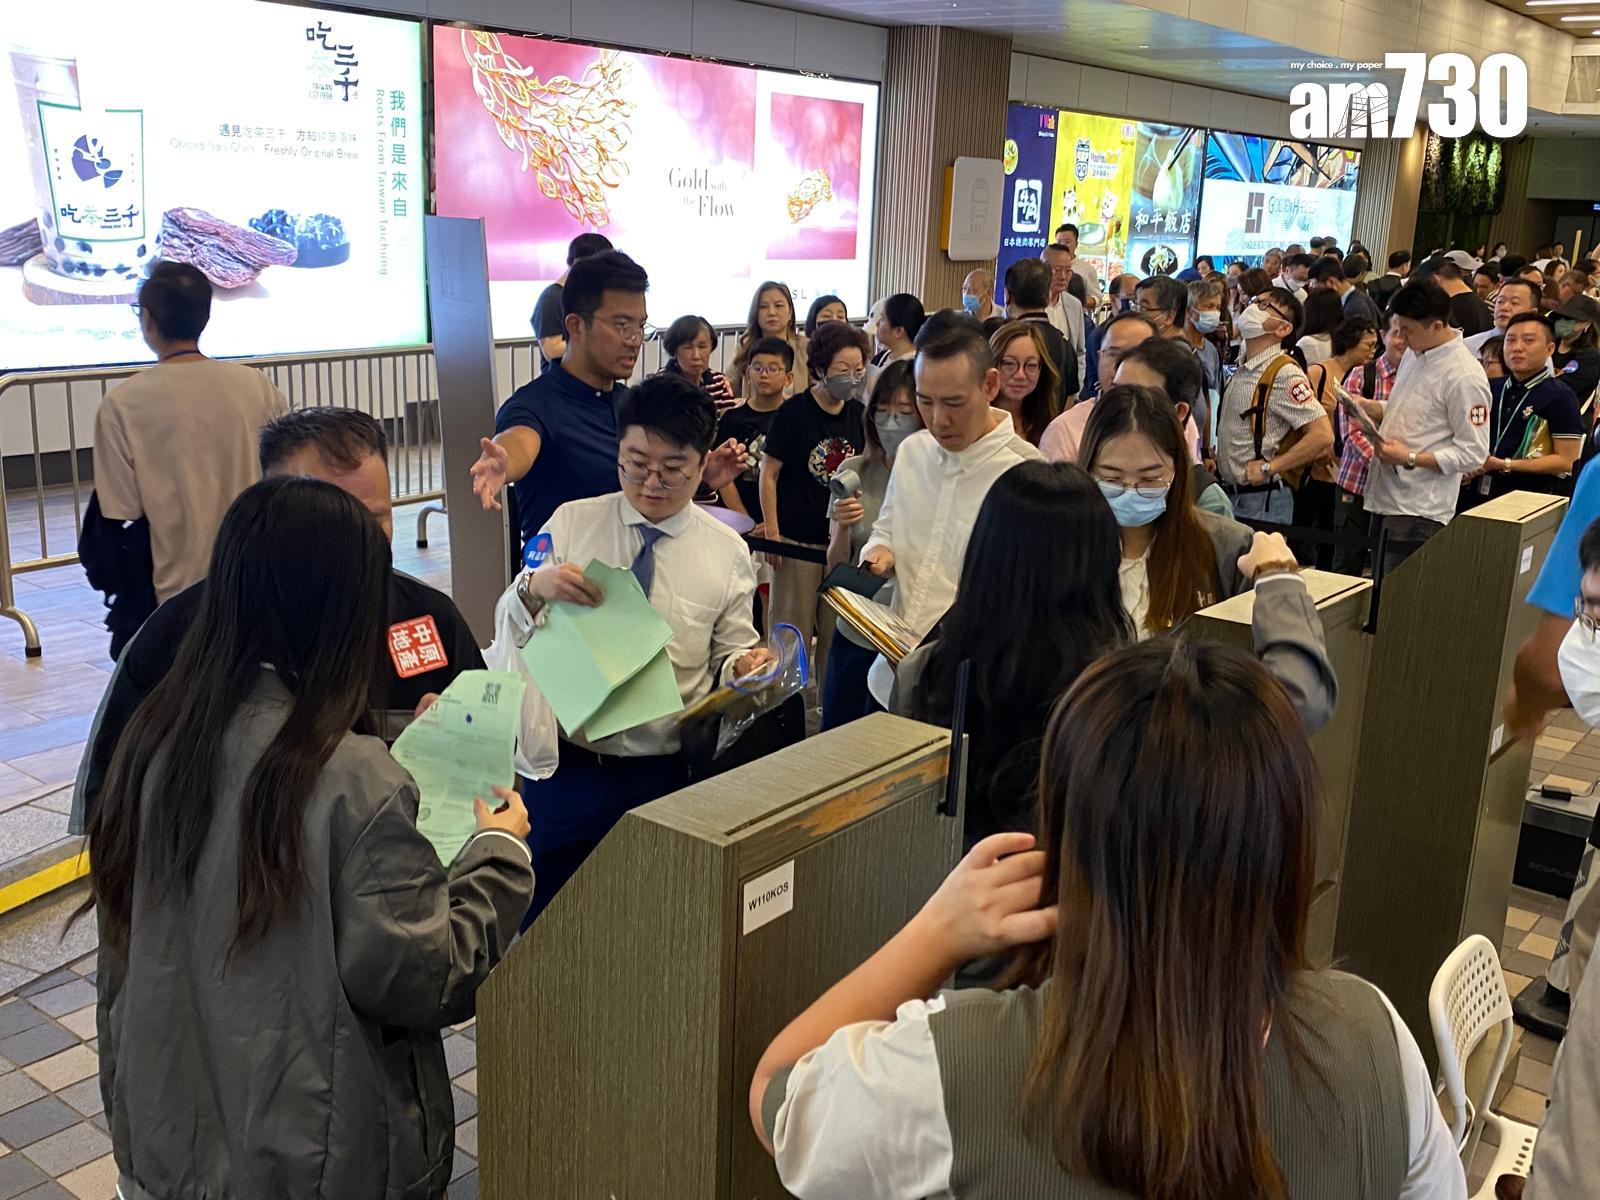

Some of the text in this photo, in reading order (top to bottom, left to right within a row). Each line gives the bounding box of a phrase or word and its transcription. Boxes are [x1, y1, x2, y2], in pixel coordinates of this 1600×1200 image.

[264, 143, 297, 157] Freshly
[668, 166, 708, 190] Gold
[698, 194, 736, 217] Flow
[748, 881, 789, 912] W110KOS
